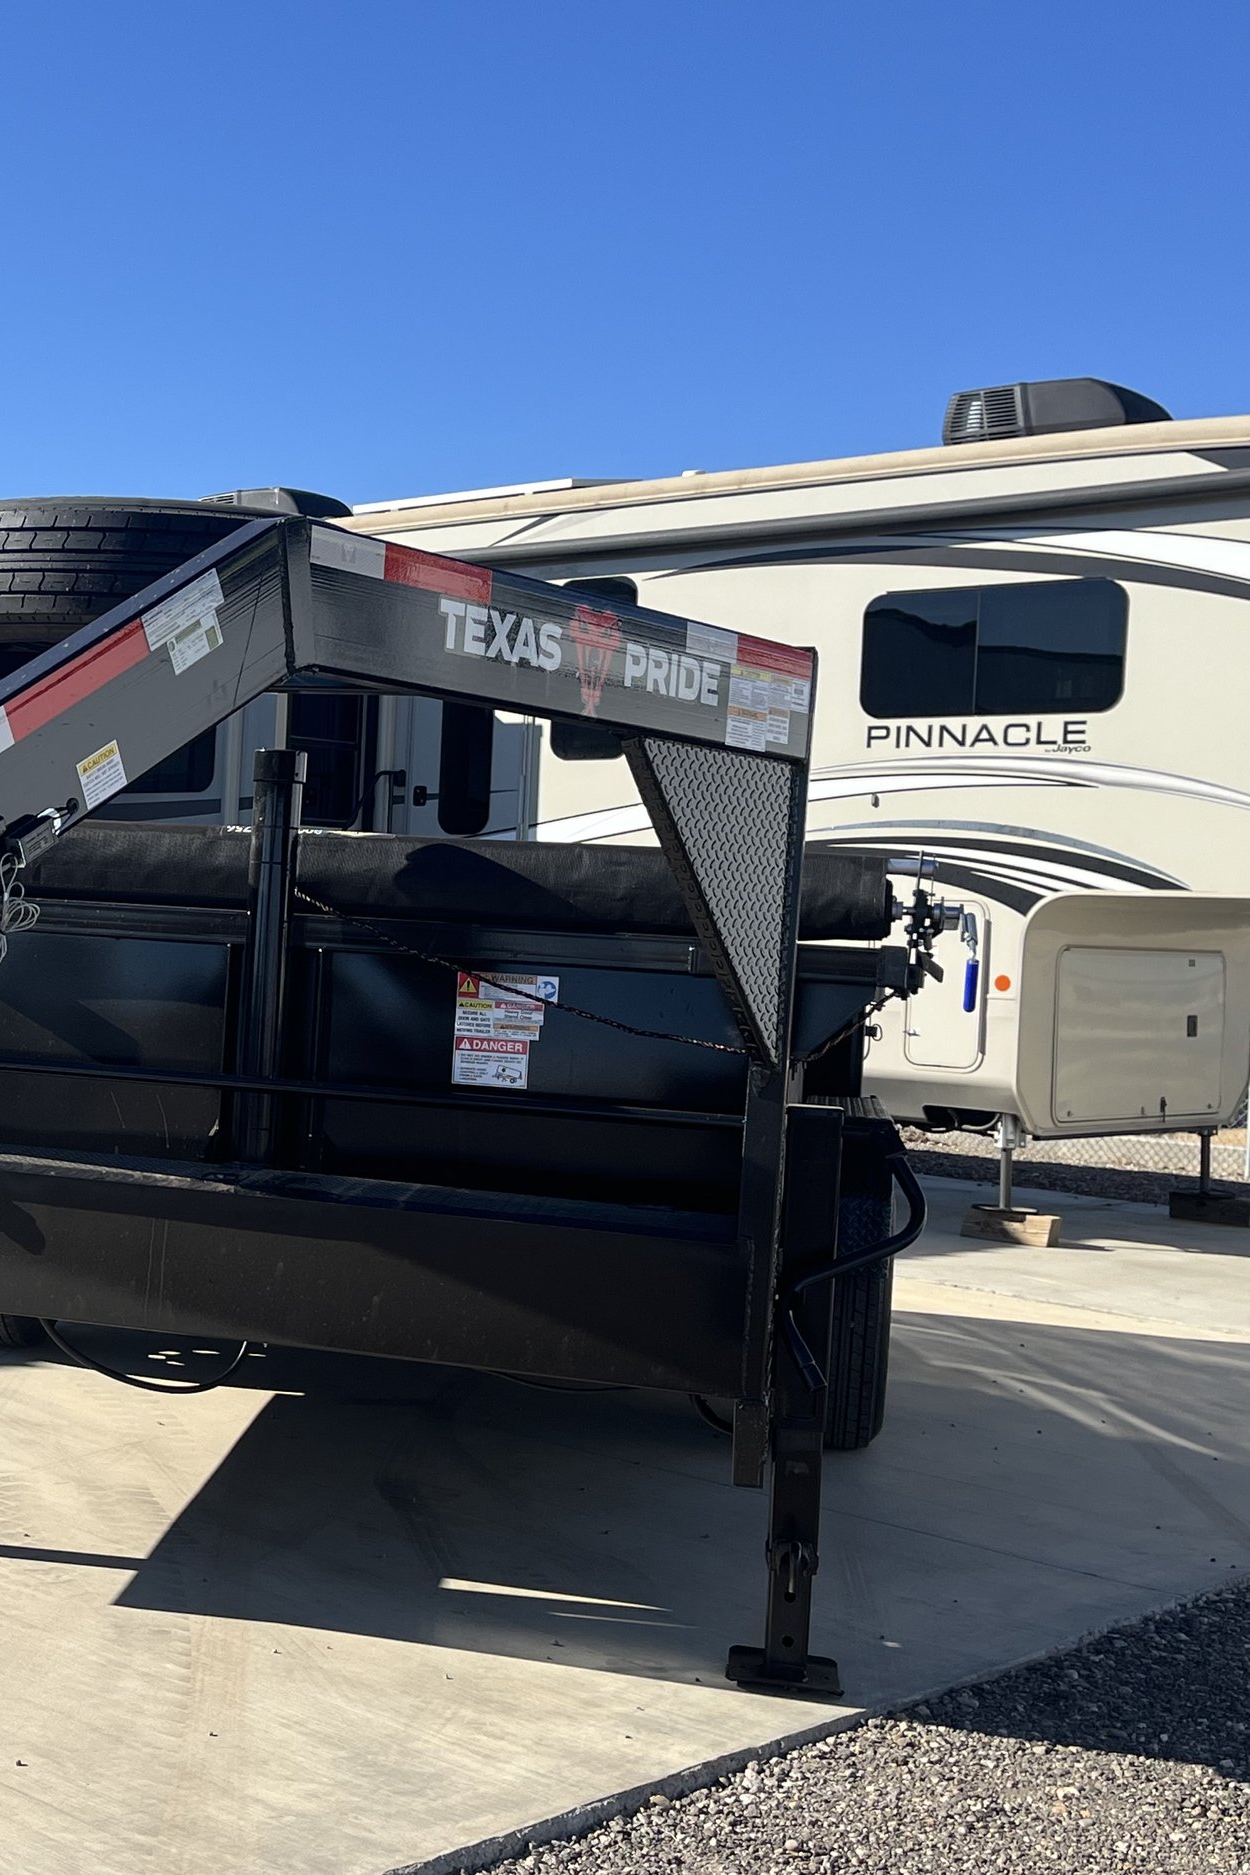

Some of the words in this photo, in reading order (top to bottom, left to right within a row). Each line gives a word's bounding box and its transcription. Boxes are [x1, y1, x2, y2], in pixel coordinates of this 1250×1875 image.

[439, 598, 562, 671] TEXAS
[623, 643, 721, 706] PRIDE
[866, 720, 1088, 748] PINNACLE
[87, 746, 115, 769] CAUTION
[1052, 744, 1091, 755] Jayco
[491, 974, 535, 984] WARNING
[472, 1040, 523, 1052] DANGER
